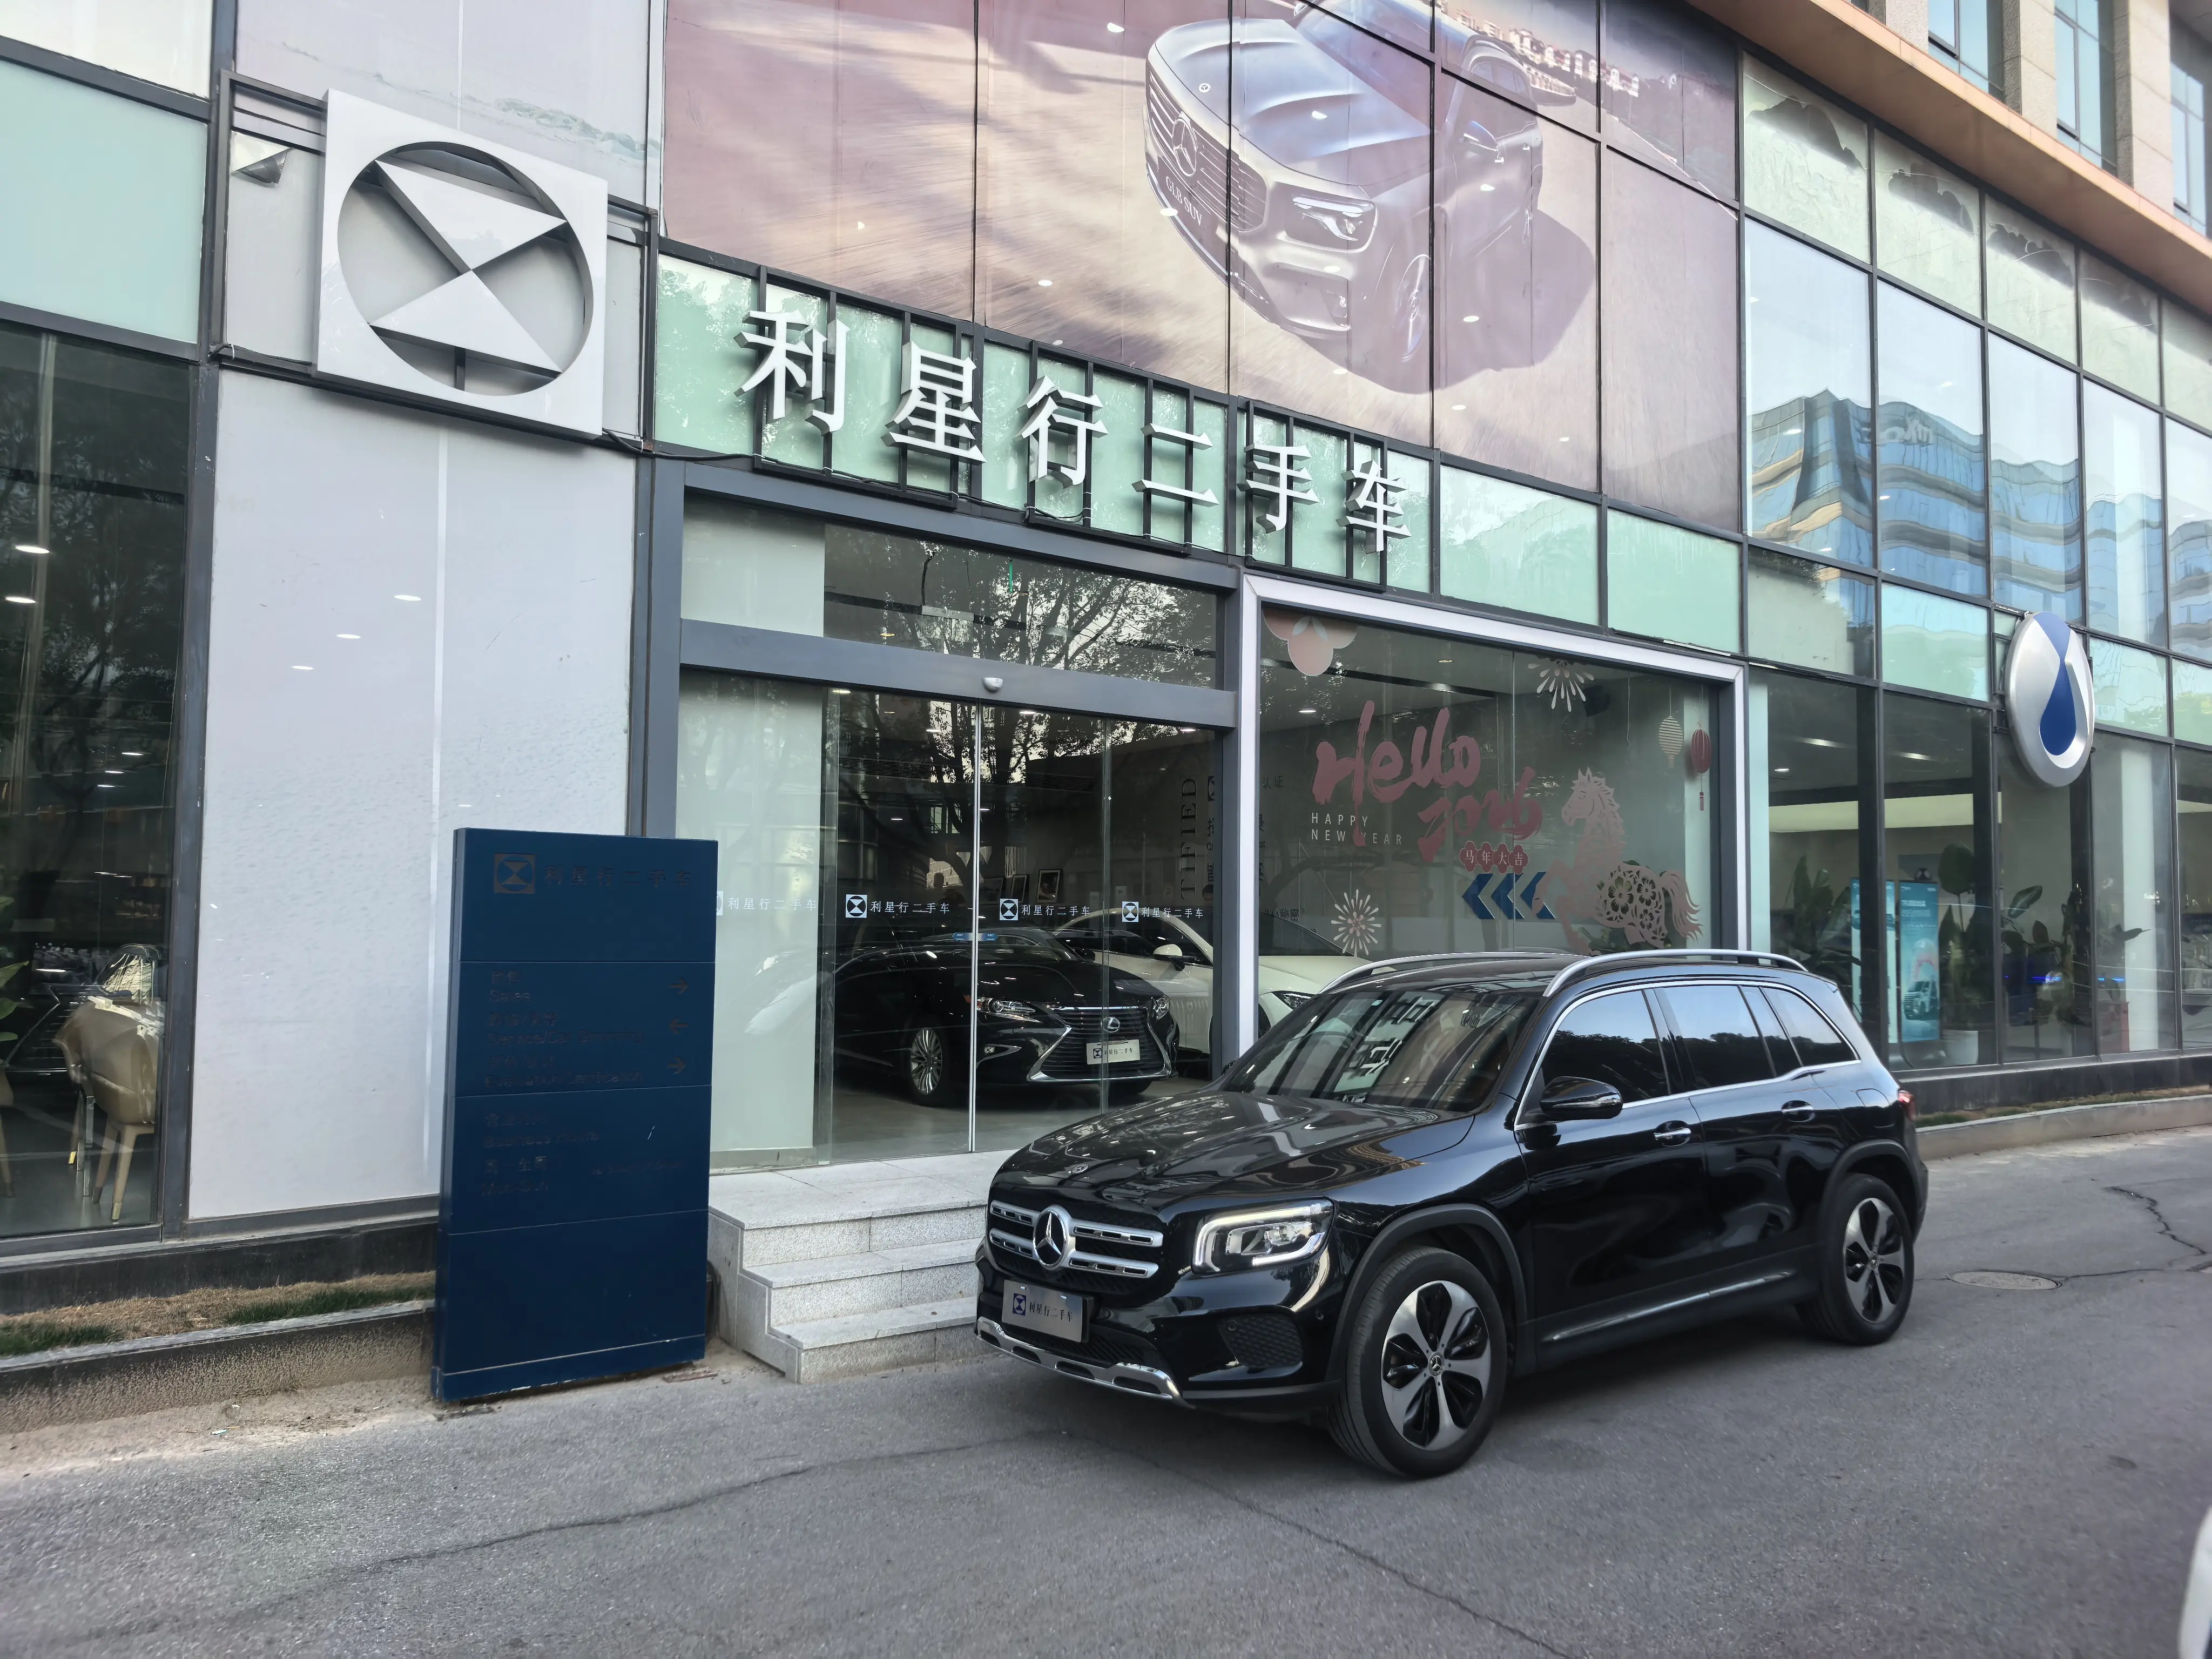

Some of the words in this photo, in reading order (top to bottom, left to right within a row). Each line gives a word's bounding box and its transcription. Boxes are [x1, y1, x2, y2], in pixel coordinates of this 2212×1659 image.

[1166, 176, 1183, 204] GLB
[1184, 197, 1202, 226] SUV
[733, 309, 1412, 555] 利星行二手车
[1312, 700, 1481, 847] Hello
[1311, 812, 1368, 827] HAPPY
[1311, 828, 1346, 841] NEW
[1360, 832, 1402, 845] YEAR
[1464, 849, 1523, 866] 马年大吉
[727, 897, 817, 911] 利星行二手车
[869, 900, 950, 914] 利星行二手车
[1021, 904, 1090, 916] 利星行二手车
[1141, 907, 1203, 919] 利星行二手车
[1029, 1301, 1073, 1322] 利星行二手车
